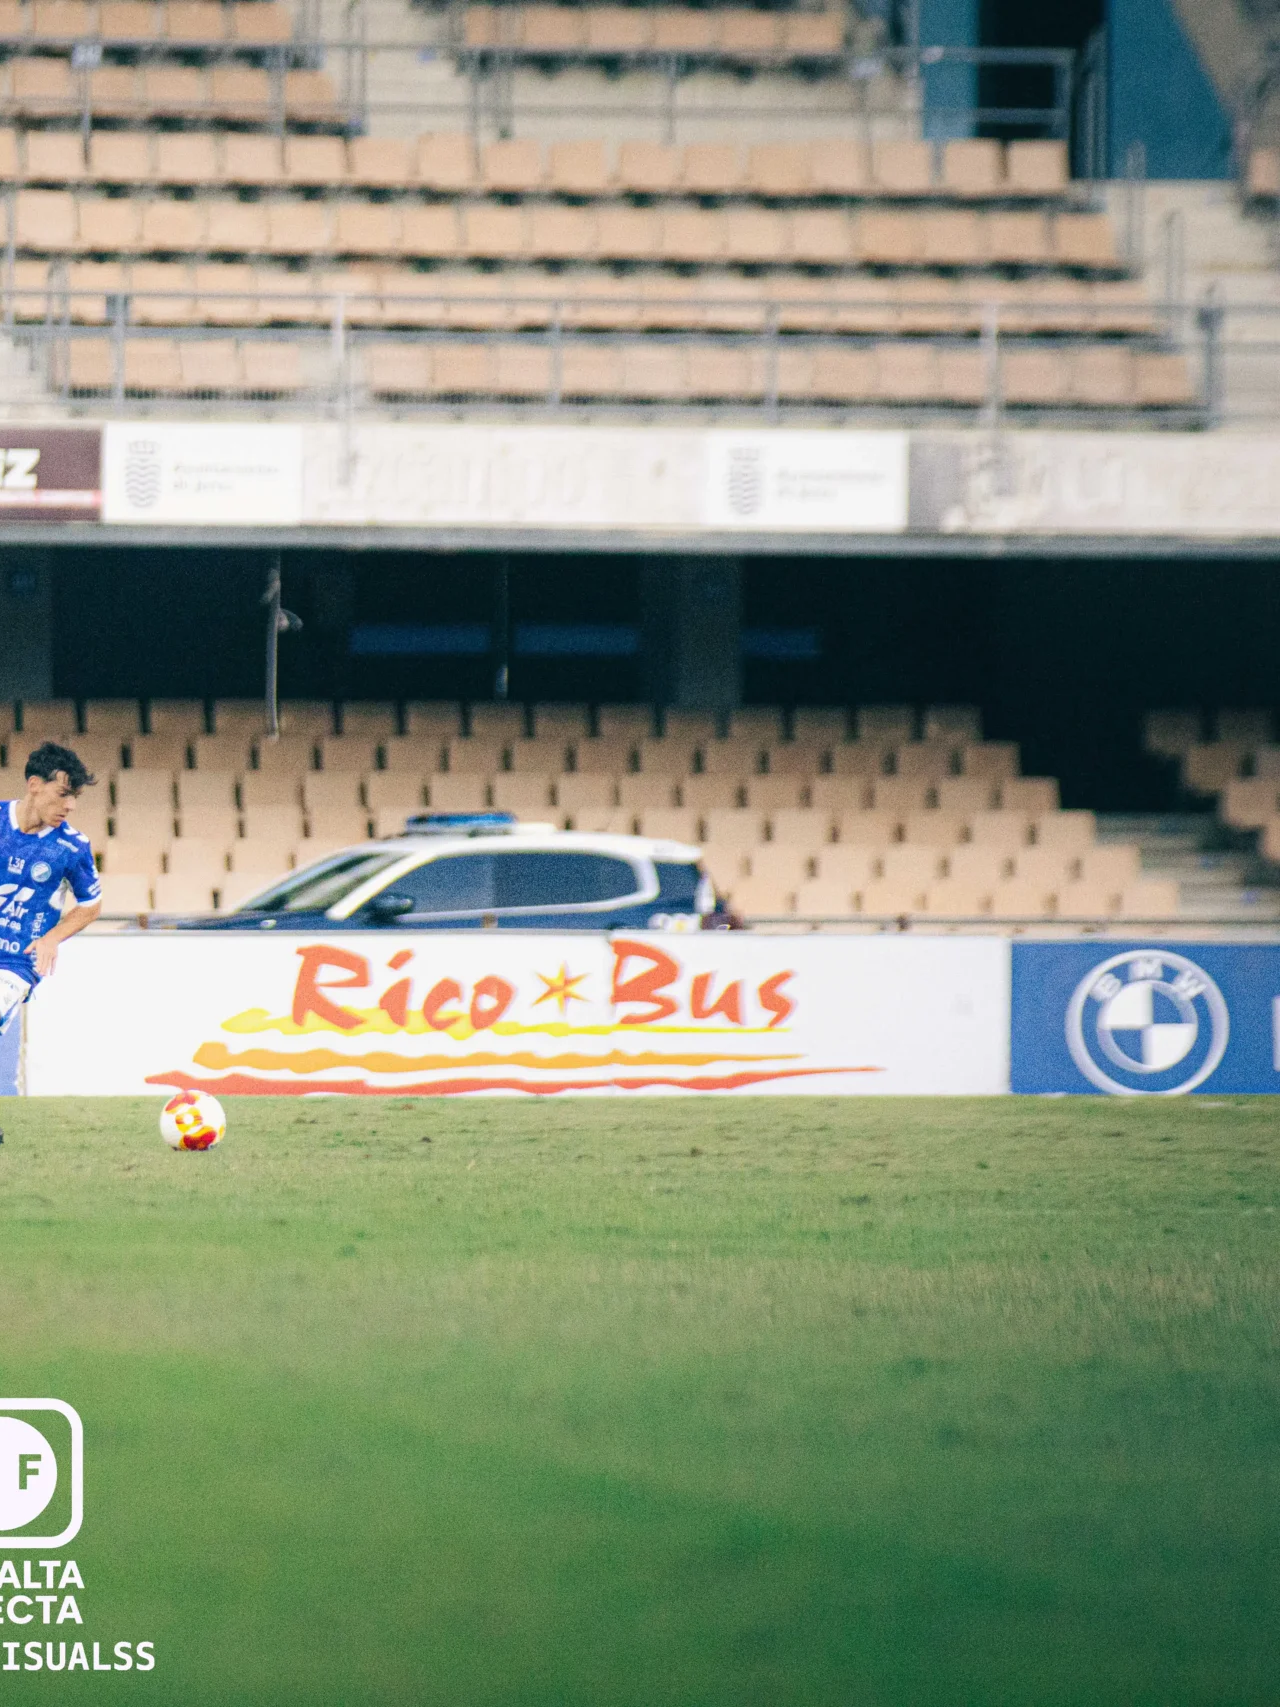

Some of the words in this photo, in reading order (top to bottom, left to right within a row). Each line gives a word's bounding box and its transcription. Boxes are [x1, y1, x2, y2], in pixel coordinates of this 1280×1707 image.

[2, 900, 29, 919] Air
[610, 939, 797, 1029] Bus
[1089, 957, 1207, 1002] BMW
